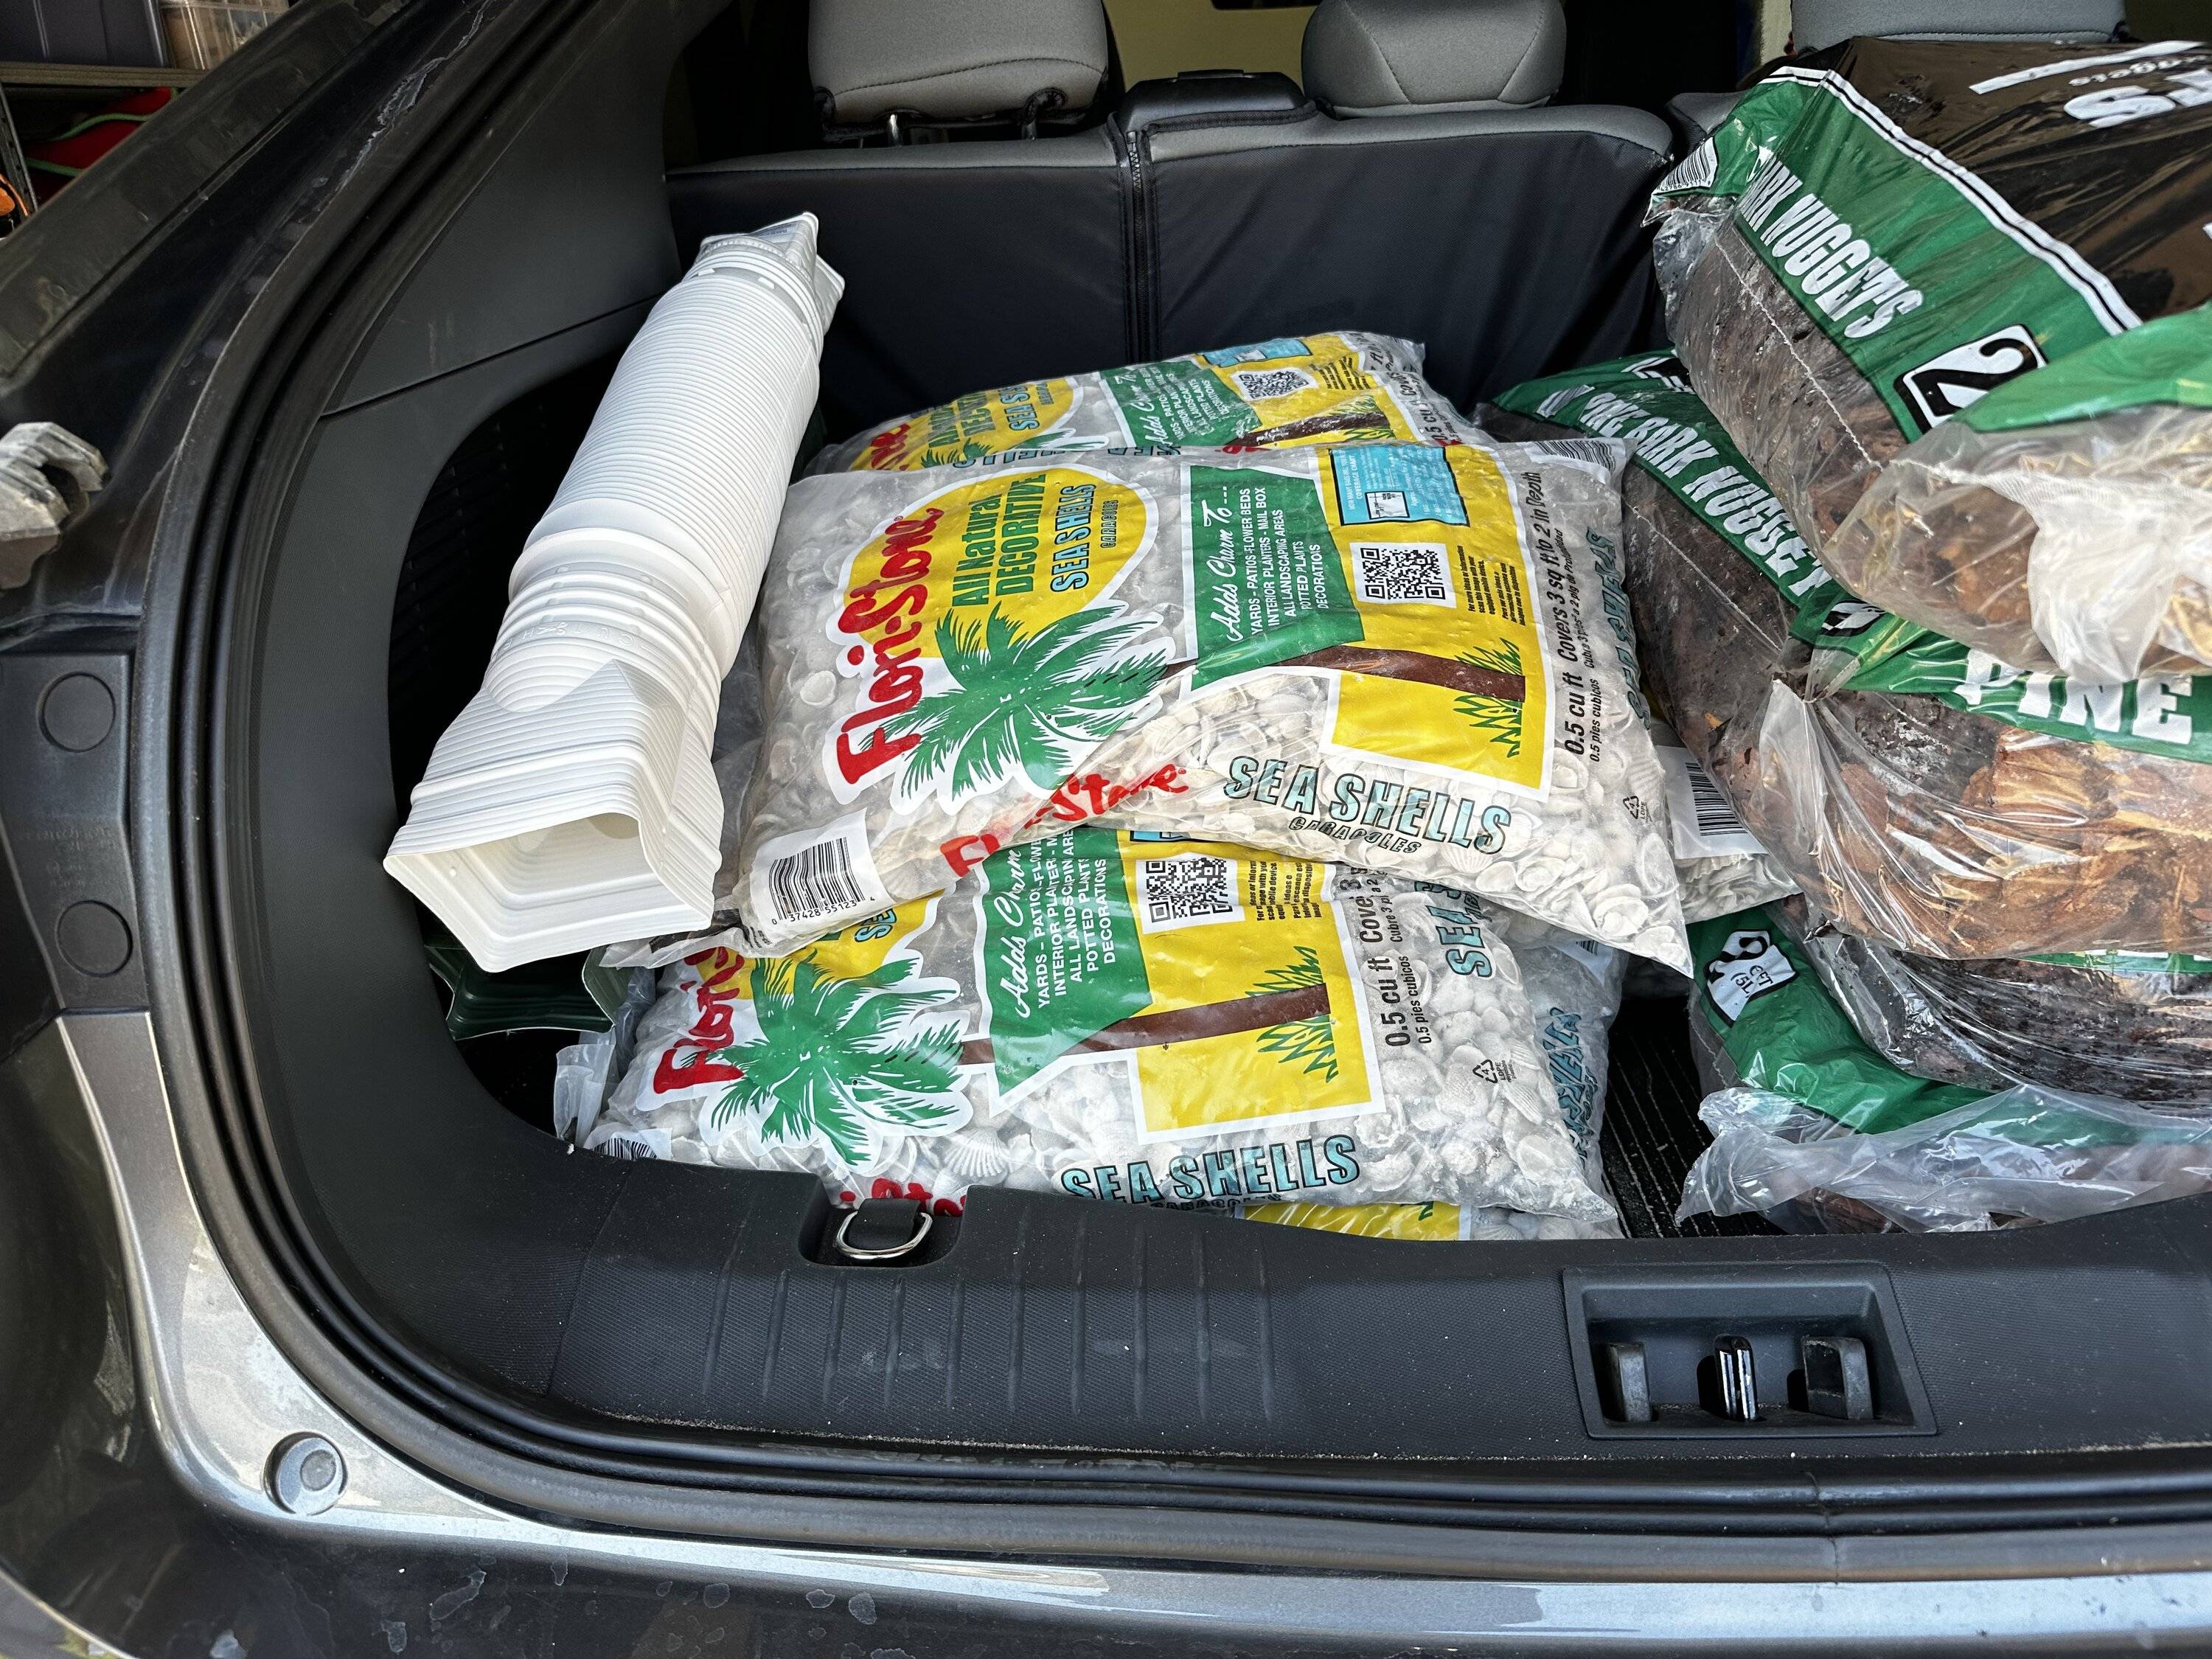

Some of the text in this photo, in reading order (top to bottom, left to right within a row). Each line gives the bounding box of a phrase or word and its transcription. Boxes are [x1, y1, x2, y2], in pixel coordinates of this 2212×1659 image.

[1760, 193, 1923, 338] NUGGETS
[1624, 417, 1720, 479] BARK
[1239, 488, 1251, 515] BEDS
[1254, 487, 1267, 509] BOX
[1521, 471, 1547, 507] Depth
[1256, 510, 1267, 529] MAIL
[1272, 509, 1285, 537] AREAS
[1530, 507, 1550, 524] in
[995, 474, 1048, 596] DECORATIVE
[1050, 484, 1097, 592] SEA SHELLS
[1533, 522, 1551, 538] 2
[951, 493, 1002, 608] All Natural
[1206, 529, 1237, 578] Charm
[1259, 536, 1275, 577] PLANTERS
[1276, 538, 1294, 601] LANDSCAPING
[1548, 568, 1565, 591] sq
[1296, 574, 1309, 611] POTTED
[1463, 577, 1472, 591] ideas
[1466, 591, 1475, 604] more
[1472, 576, 1481, 592] image
[1210, 582, 1244, 642] Adds
[1263, 582, 1280, 626] INTERIOR
[1467, 604, 1476, 612] For
[1478, 601, 1486, 613] scan
[1546, 591, 1566, 606] 3
[1570, 597, 1579, 608] 2
[1248, 598, 1263, 636] YARDS
[1501, 608, 1509, 620] Para
[1553, 606, 1579, 663] Covers
[1577, 633, 1588, 643] 3
[1581, 642, 1596, 669] Cubre
[1562, 672, 1584, 689] ft
[1565, 692, 1586, 717] cu
[1589, 678, 1602, 717] cubicos
[1953, 648, 2194, 745] PINE
[1564, 720, 1585, 756] 0.5
[1590, 719, 1603, 744] pies
[1589, 745, 1601, 762] 0.5
[1223, 755, 1512, 855] SEA SHELLS
[1366, 877, 1380, 886] 2
[788, 908, 821, 922] 37428
[824, 900, 858, 914] 55123
[1094, 858, 1116, 964] DECORATIONS
[993, 849, 1031, 1018] Adds Charm
[1081, 908, 1099, 973] POTTED
[1385, 915, 1403, 942] Cubre
[1049, 921, 1067, 996] INTERIOR
[1069, 953, 1082, 982] ALL
[1367, 957, 1393, 972] ft
[1034, 954, 1051, 1009] YARDS
[1398, 956, 1420, 998] cubicos
[1378, 979, 1401, 1004] cu
[1411, 999, 1429, 1026] pies
[1381, 1012, 1411, 1047] 0.5
[1418, 1024, 1433, 1045] 0.5
[1494, 1062, 1506, 1082] LDPE
[1061, 1134, 1360, 1205] SEA SHELLS
